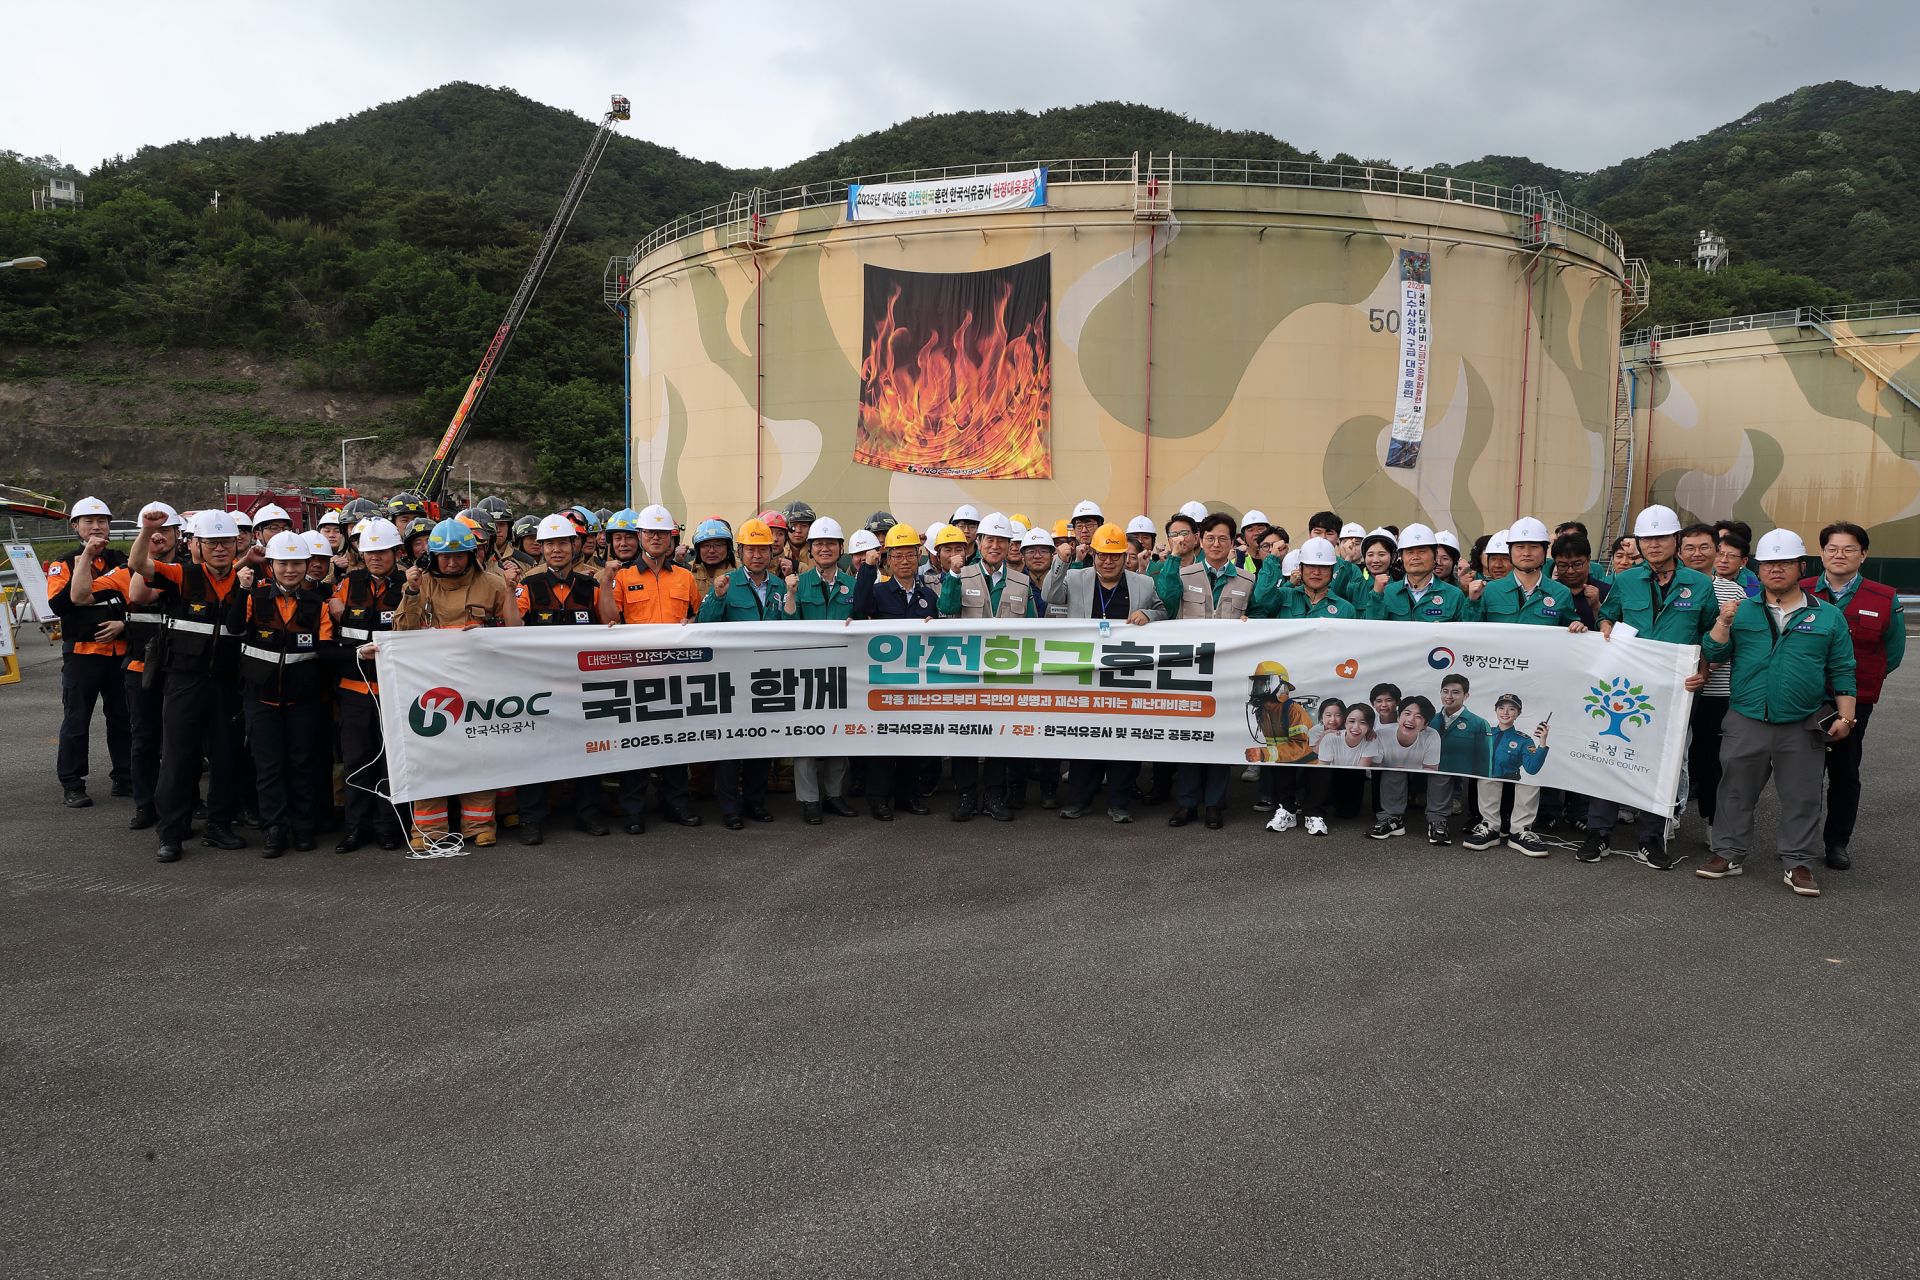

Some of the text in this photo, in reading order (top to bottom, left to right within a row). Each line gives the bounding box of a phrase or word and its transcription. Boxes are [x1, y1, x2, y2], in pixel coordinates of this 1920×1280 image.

[857, 192, 881, 207] 2025년
[882, 191, 907, 207] 재난대응
[950, 184, 991, 203] 한국석유공사
[1369, 308, 1400, 333] 50
[1406, 290, 1417, 336] 다수사상자
[587, 652, 633, 667] 대한민국
[1462, 654, 1529, 672] 행정안전부
[582, 634, 1216, 724] 국민과 함께 안전한국훈련
[408, 686, 552, 738] KNOC
[881, 694, 1202, 712] 각종 재난으로부터 국민의 생명과 재산을 지키는 재난대비훈련
[465, 720, 536, 739] 한국석유공사
[585, 739, 611, 754] 일시
[620, 728, 723, 749] 2025.5.22.(목)
[726, 726, 768, 739] 14:00
[784, 724, 826, 737] 16:00
[832, 724, 838, 735] /
[844, 723, 868, 735] 장소
[876, 723, 945, 736] 한국석유공사
[948, 723, 993, 736] 곡성지사
[999, 725, 1006, 736] /
[1012, 724, 1035, 737] 주관
[1044, 725, 1113, 739] 한국석유공사
[1116, 727, 1127, 739] 및
[1130, 727, 1165, 740] 곡성군
[1168, 728, 1215, 742] 공동주관
[1569, 750, 1650, 774] GOKSEONG COUNTY
[1588, 740, 1636, 761] 곡성군
